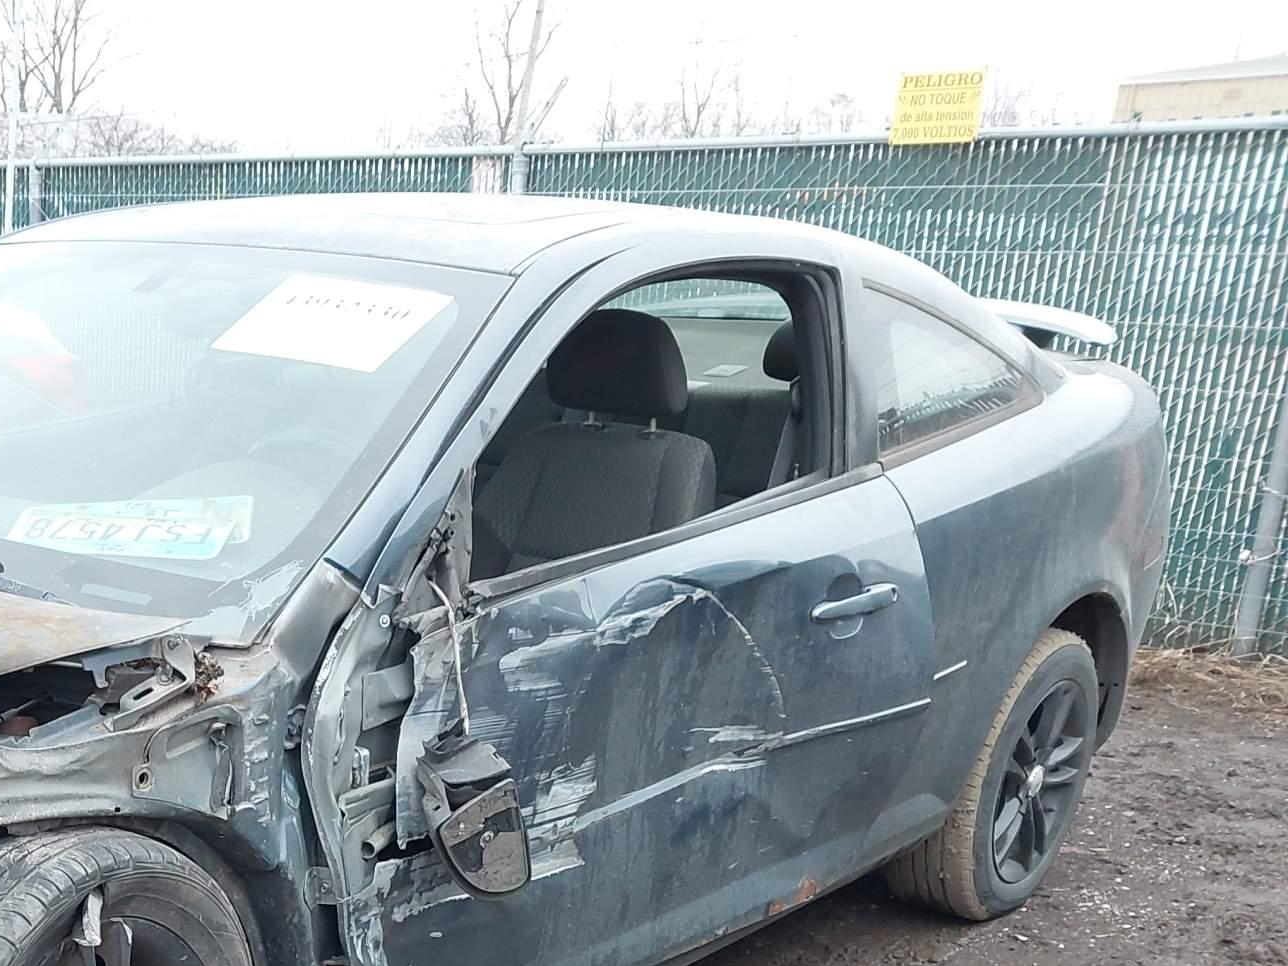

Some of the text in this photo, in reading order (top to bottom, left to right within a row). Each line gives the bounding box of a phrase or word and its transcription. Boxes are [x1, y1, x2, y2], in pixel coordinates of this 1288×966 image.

[902, 72, 983, 89] PELIGRO
[910, 92, 967, 106] NO TOQUE
[899, 111, 911, 123] de
[893, 125, 975, 141] 7,000 VOLTIOS
[24, 518, 126, 542] 4578
